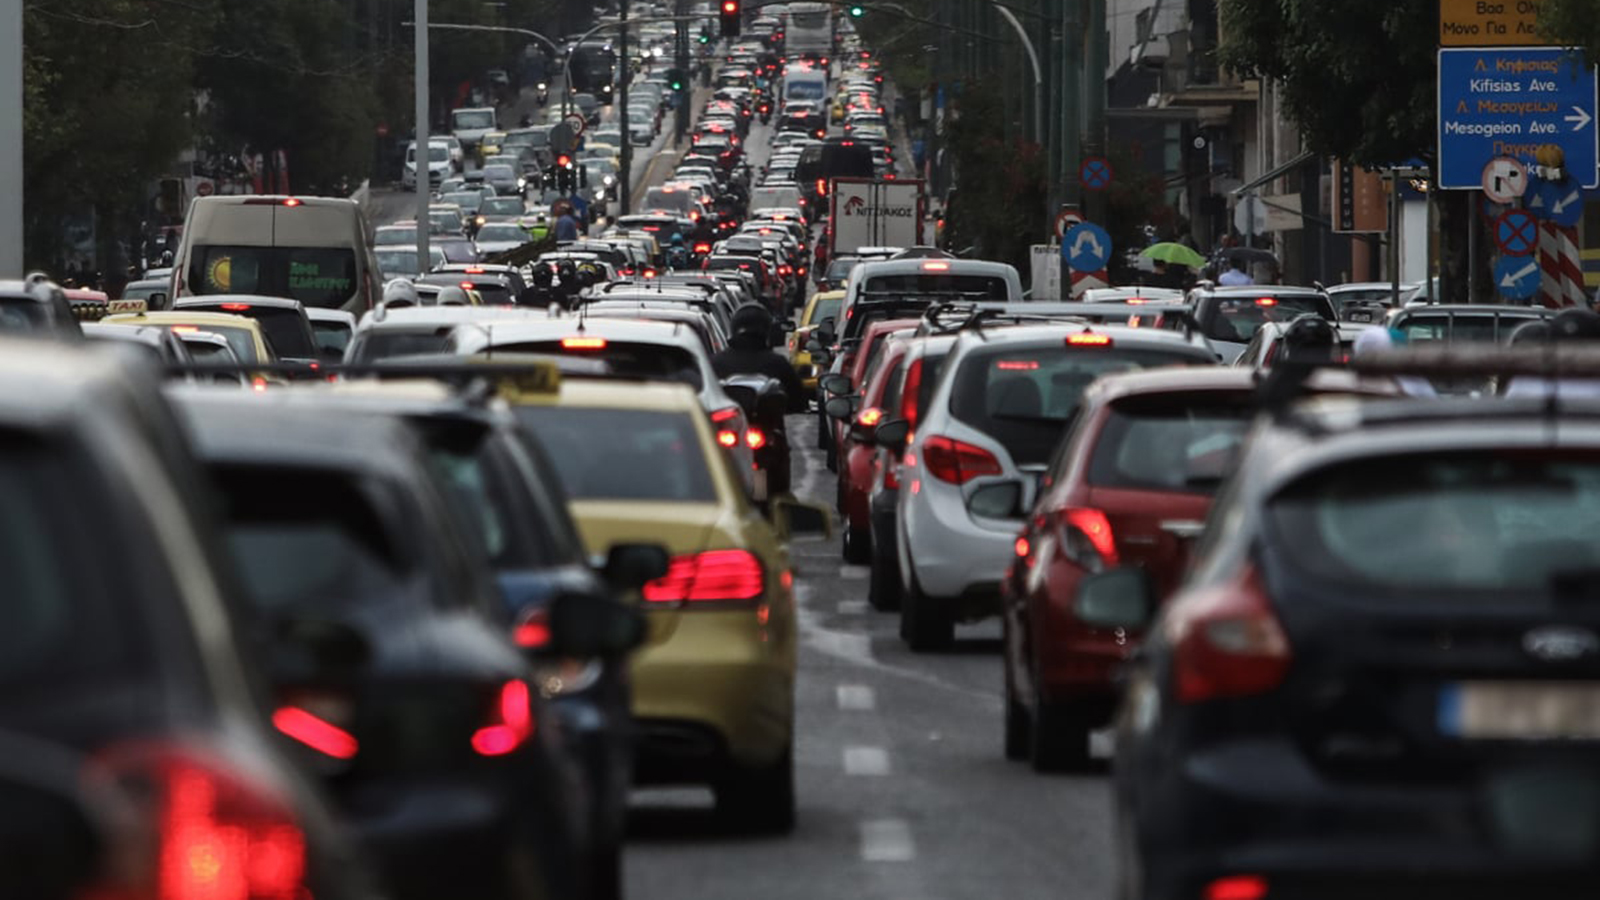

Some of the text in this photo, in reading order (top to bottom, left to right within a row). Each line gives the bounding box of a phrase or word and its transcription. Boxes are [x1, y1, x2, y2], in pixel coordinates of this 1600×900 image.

[1486, 21, 1507, 34] Για
[1470, 78, 1559, 92] Kifisias Ave.
[1445, 120, 1559, 138] Mesogeion Ave.
[112, 302, 143, 312] TAXI
